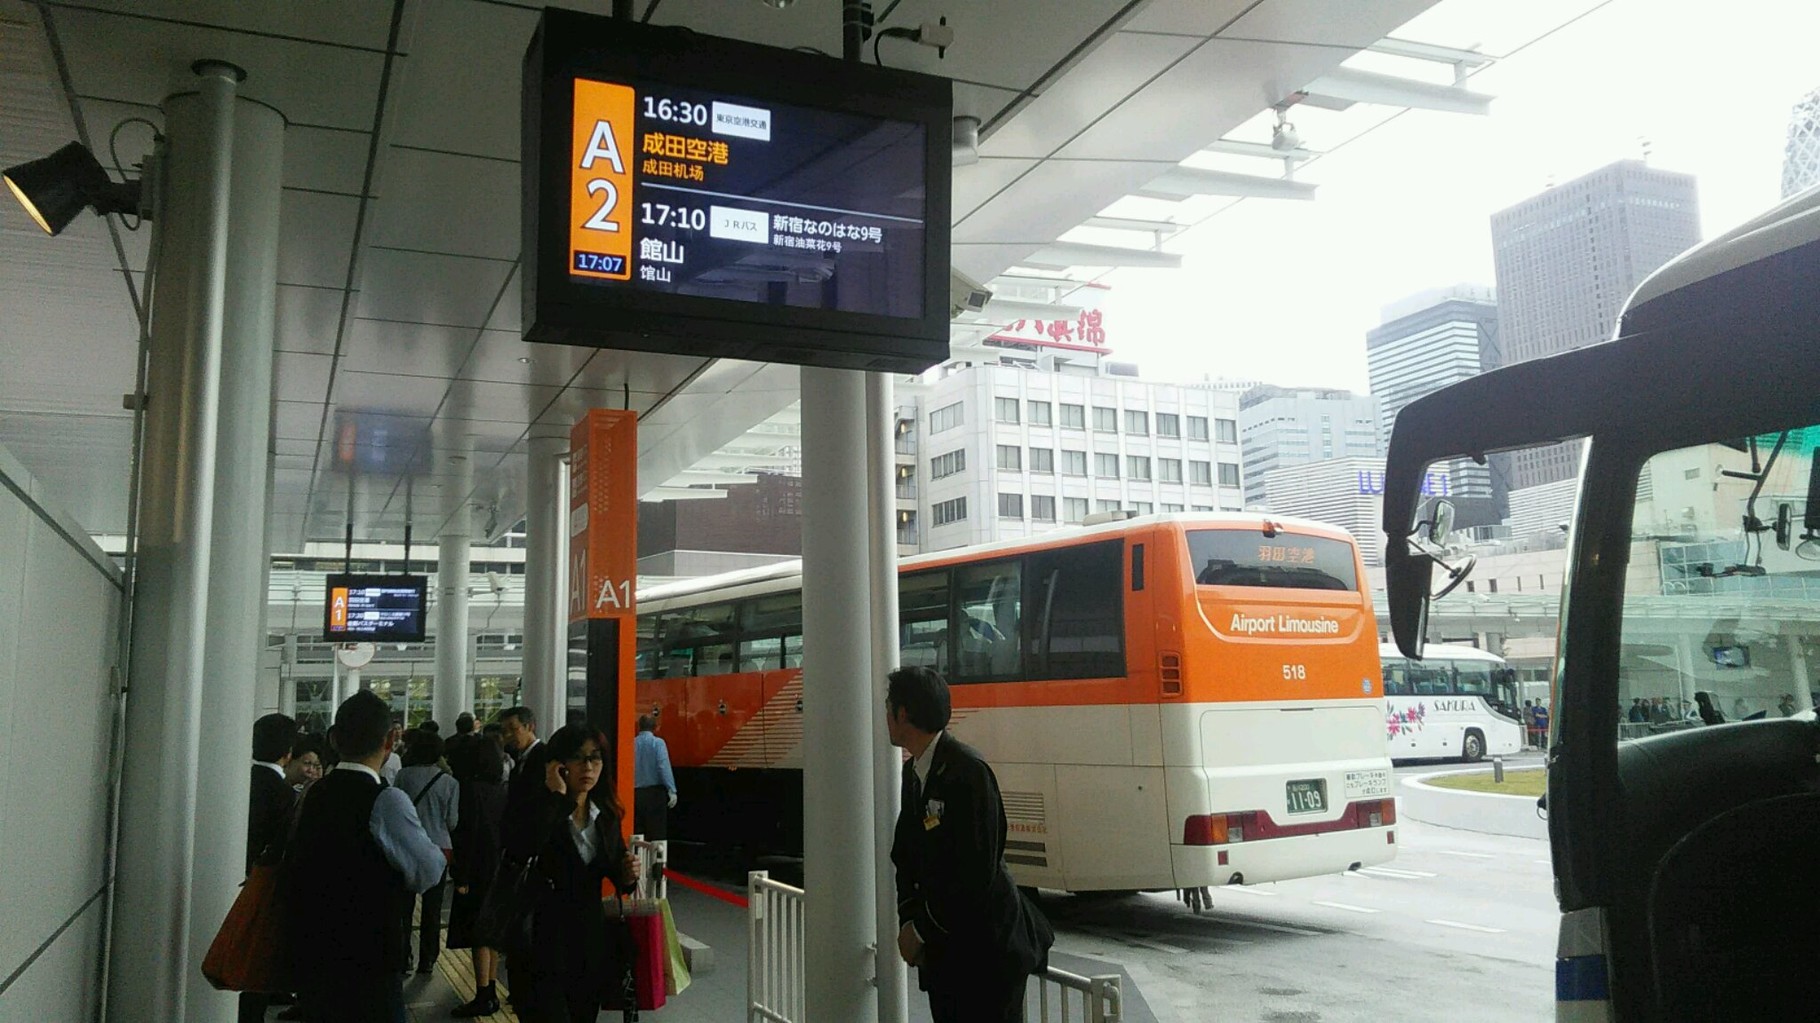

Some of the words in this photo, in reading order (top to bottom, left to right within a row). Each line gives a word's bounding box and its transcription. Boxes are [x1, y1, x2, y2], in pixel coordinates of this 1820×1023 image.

[643, 96, 708, 126] 16:30
[716, 113, 767, 130] 東京空港交通
[579, 119, 626, 174] A
[642, 132, 729, 165] 成田空港
[642, 159, 704, 182] 成田机场
[580, 178, 620, 232] 2
[641, 202, 706, 231] 17:10
[773, 214, 883, 244] 新宿なのはな9号
[640, 237, 685, 264] 館山
[773, 234, 842, 254] 新宿油菜花9号
[578, 254, 623, 272] 17:07
[640, 265, 671, 283] 馆山
[1258, 545, 1316, 564] 羽田空港
[570, 549, 587, 613] A1
[334, 596, 345, 608] A
[595, 580, 632, 609] A1
[335, 609, 342, 621] 1
[1230, 613, 1276, 635] Airport
[1278, 615, 1339, 634] Limousine
[1282, 664, 1306, 680] 518
[1433, 699, 1476, 712] SAKURA
[1291, 790, 1321, 810] 11-09
